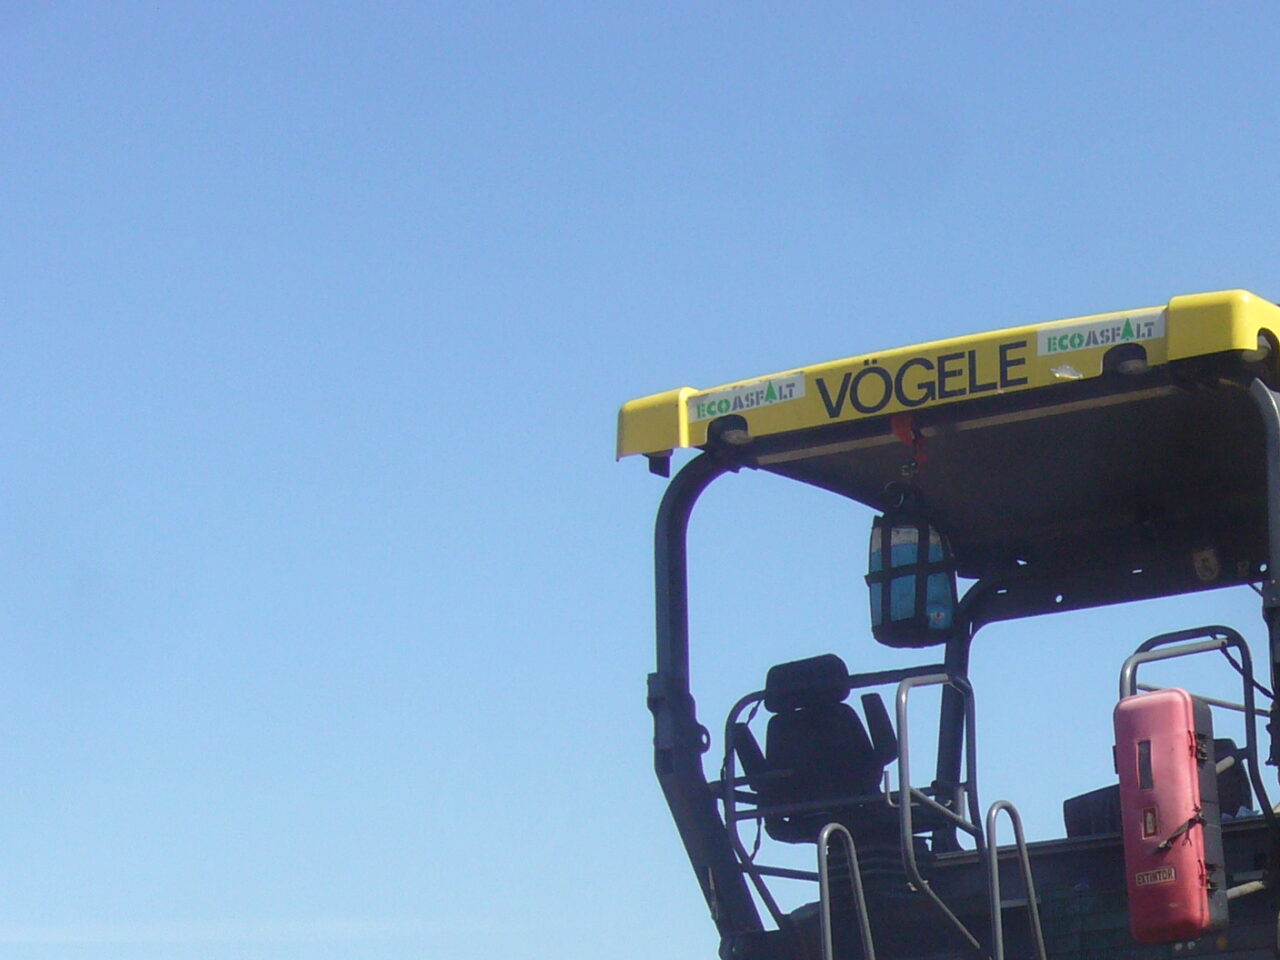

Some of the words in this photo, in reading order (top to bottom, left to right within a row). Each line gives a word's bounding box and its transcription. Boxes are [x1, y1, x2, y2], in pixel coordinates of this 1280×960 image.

[1047, 317, 1155, 353] ECOASFALT
[697, 379, 796, 419] ECOASFALT
[815, 341, 1029, 419] VÖGELE
